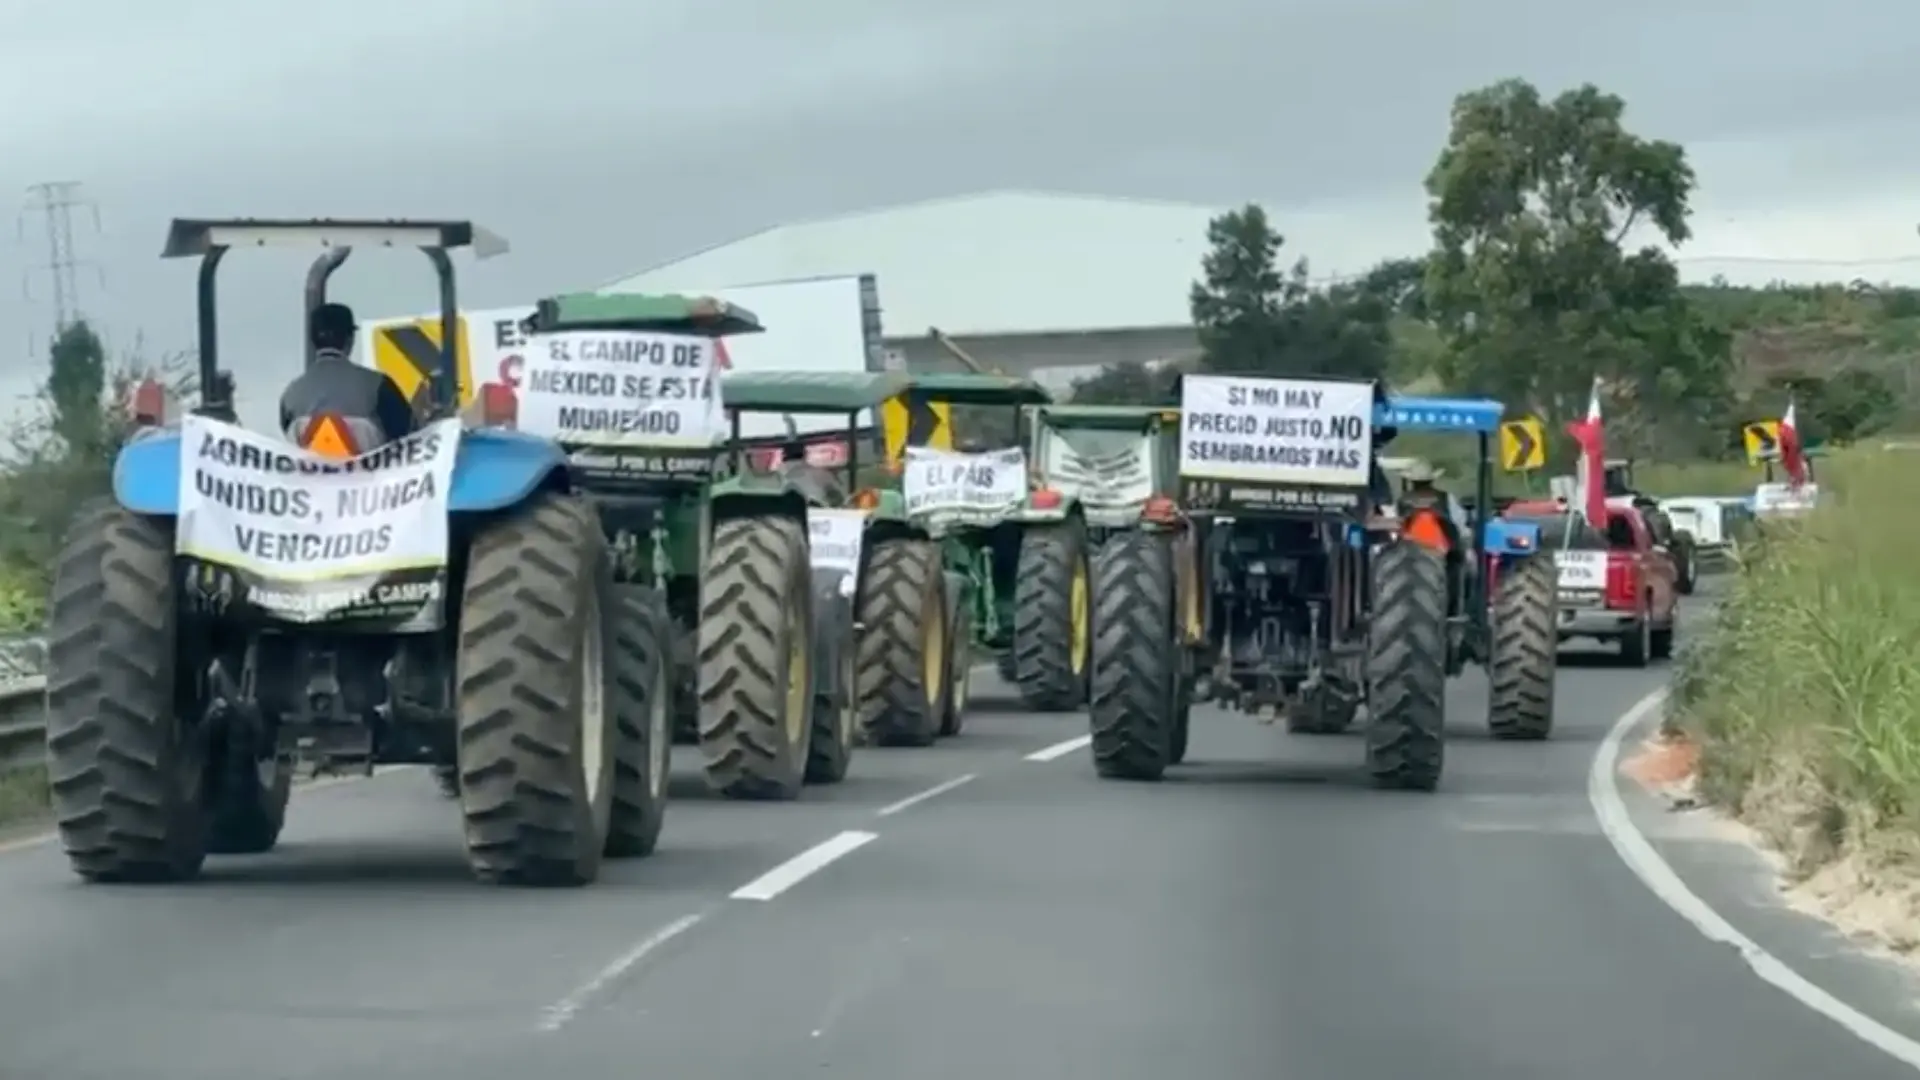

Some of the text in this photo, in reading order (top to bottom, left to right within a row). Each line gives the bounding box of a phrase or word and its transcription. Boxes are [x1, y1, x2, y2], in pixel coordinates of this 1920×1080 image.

[549, 340, 703, 368] EL CAMPO DE
[621, 374, 653, 399] SE
[1228, 386, 1323, 409] SI NO HAY
[559, 406, 680, 435] MURIENDO
[1188, 412, 1258, 434] PRECIO
[1188, 440, 1312, 467] SEMBRAMOS
[926, 464, 946, 487] EL
[195, 468, 437, 523] UNIDOS, NUNCA
[234, 523, 394, 562] VENCIDOS
